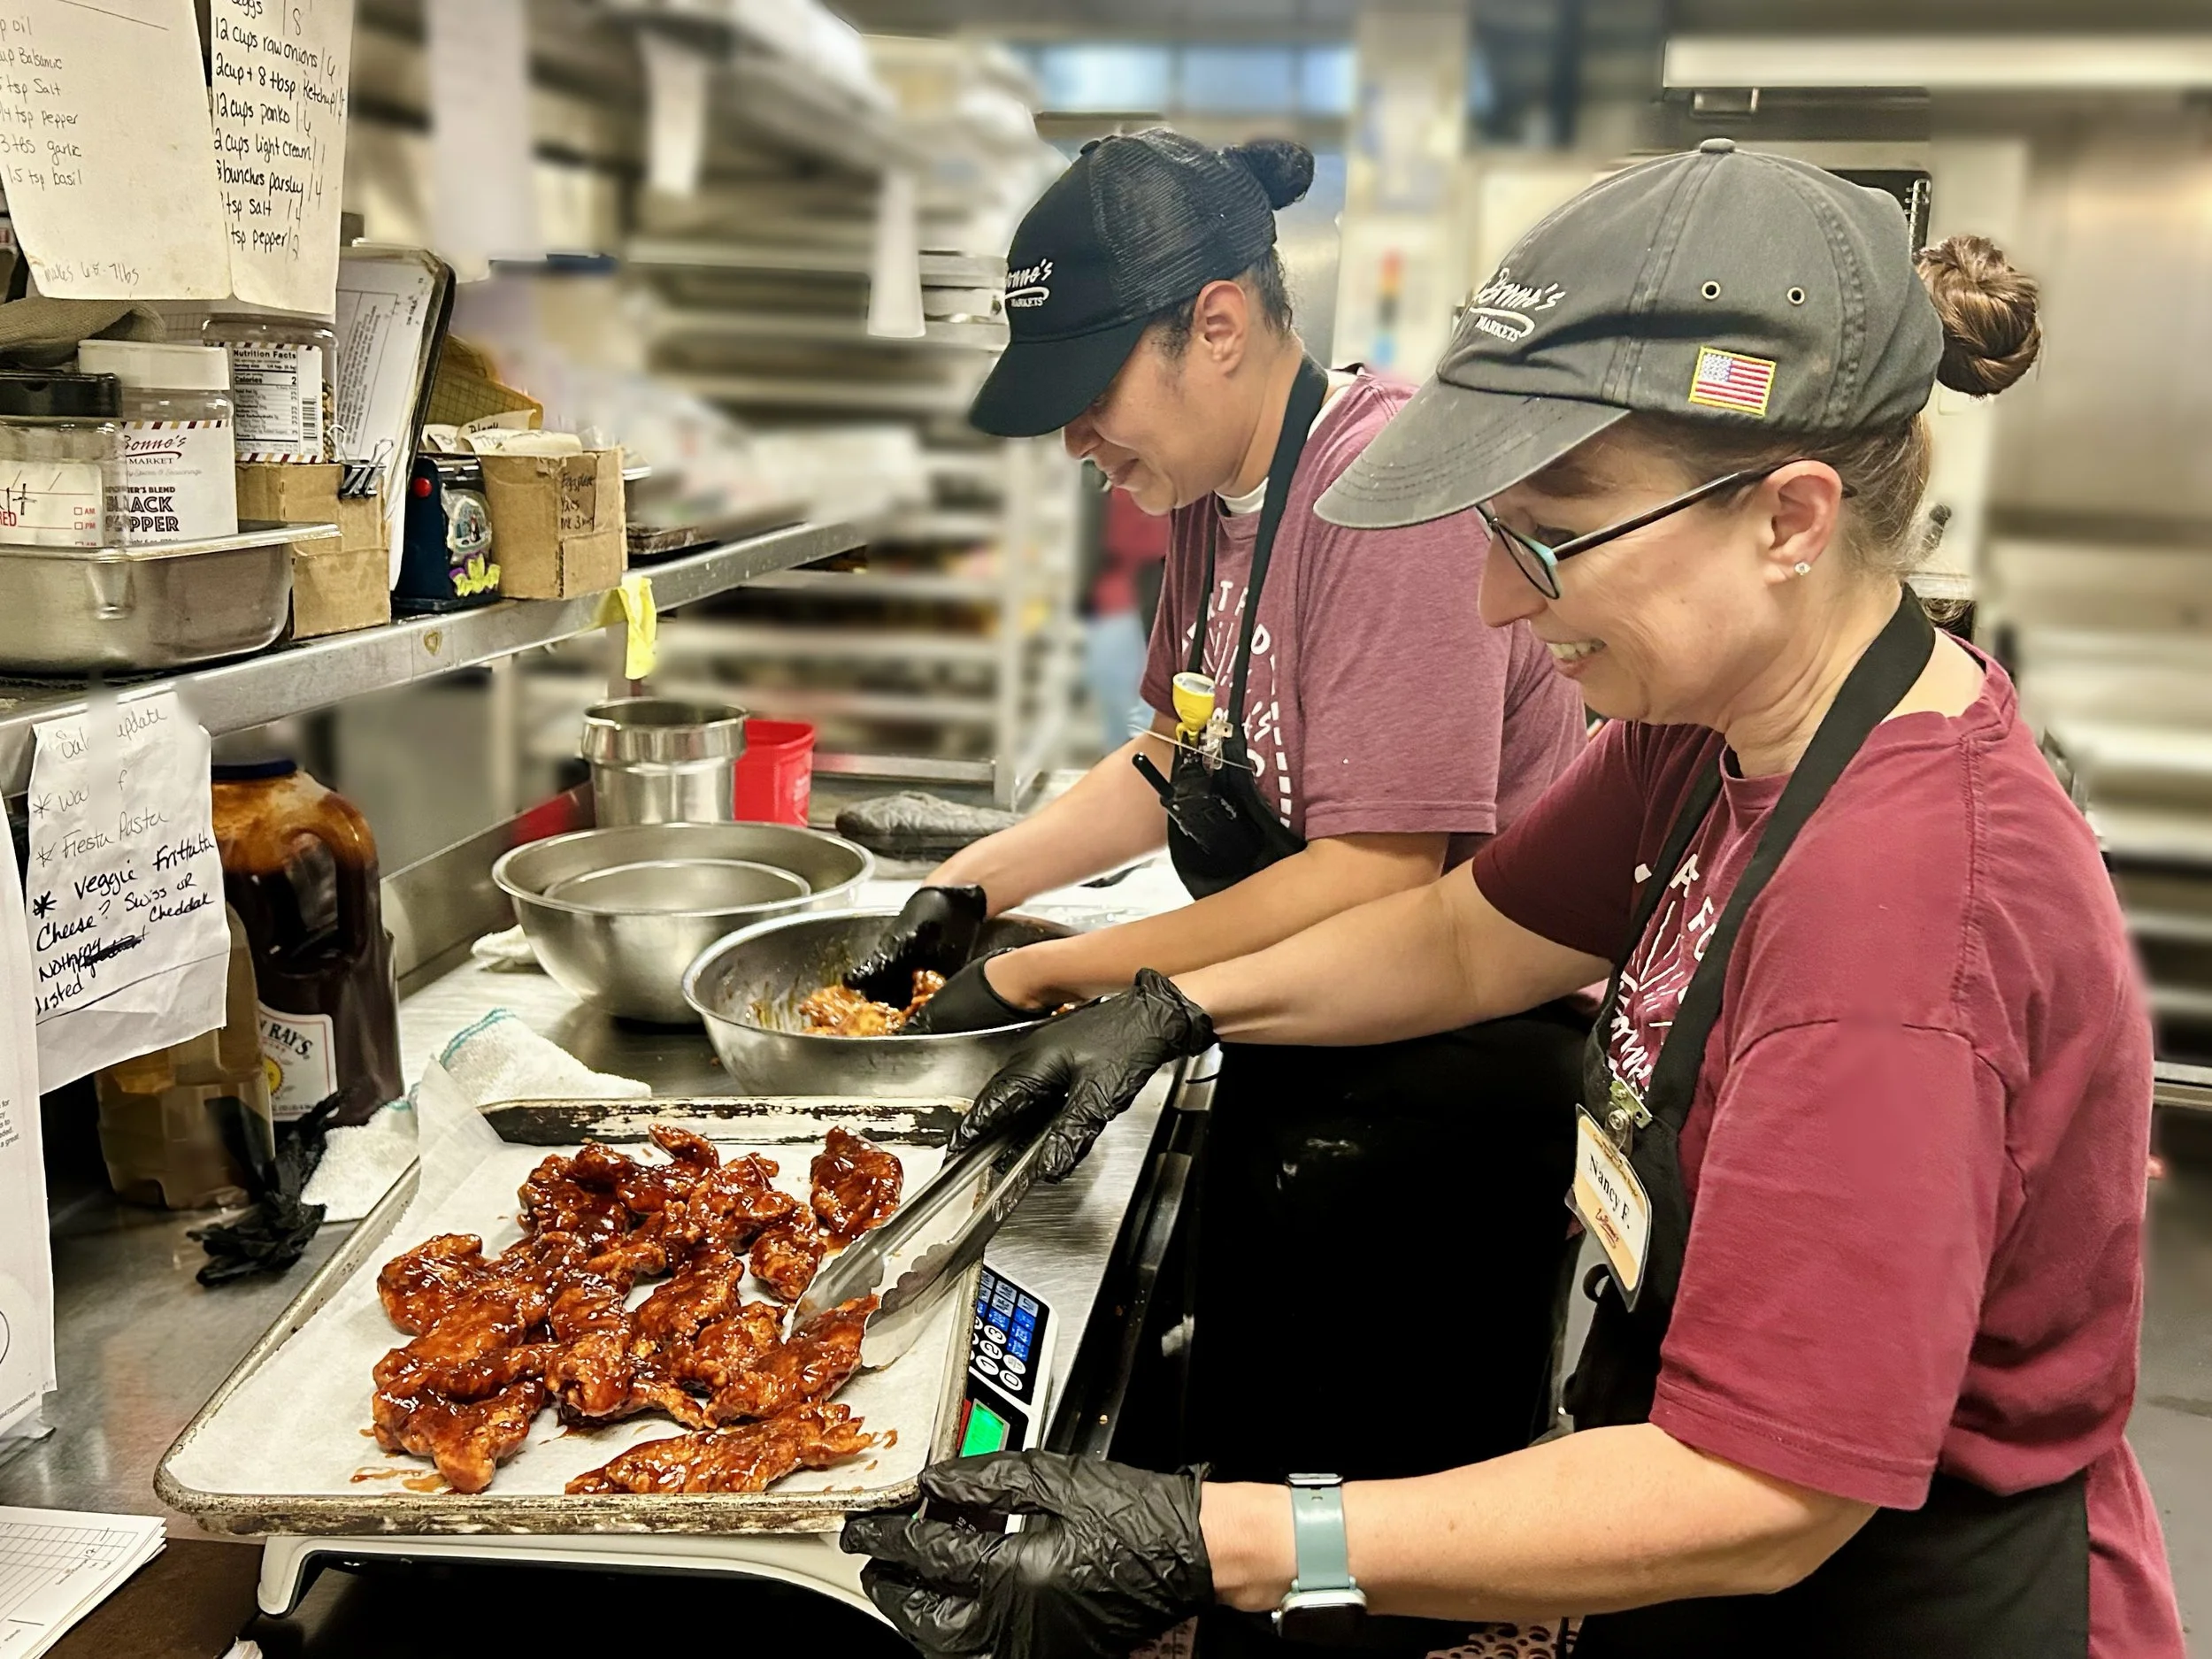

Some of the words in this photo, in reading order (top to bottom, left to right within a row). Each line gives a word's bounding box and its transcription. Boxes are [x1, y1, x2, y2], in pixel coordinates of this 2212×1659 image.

[216, 17, 228, 42] 12
[216, 92, 228, 118] 12
[52, 166, 82, 186] basil
[1475, 315, 1522, 343] MARKETS
[1590, 1153, 1618, 1212] Nancy
[1621, 1204, 1630, 1229] F.
